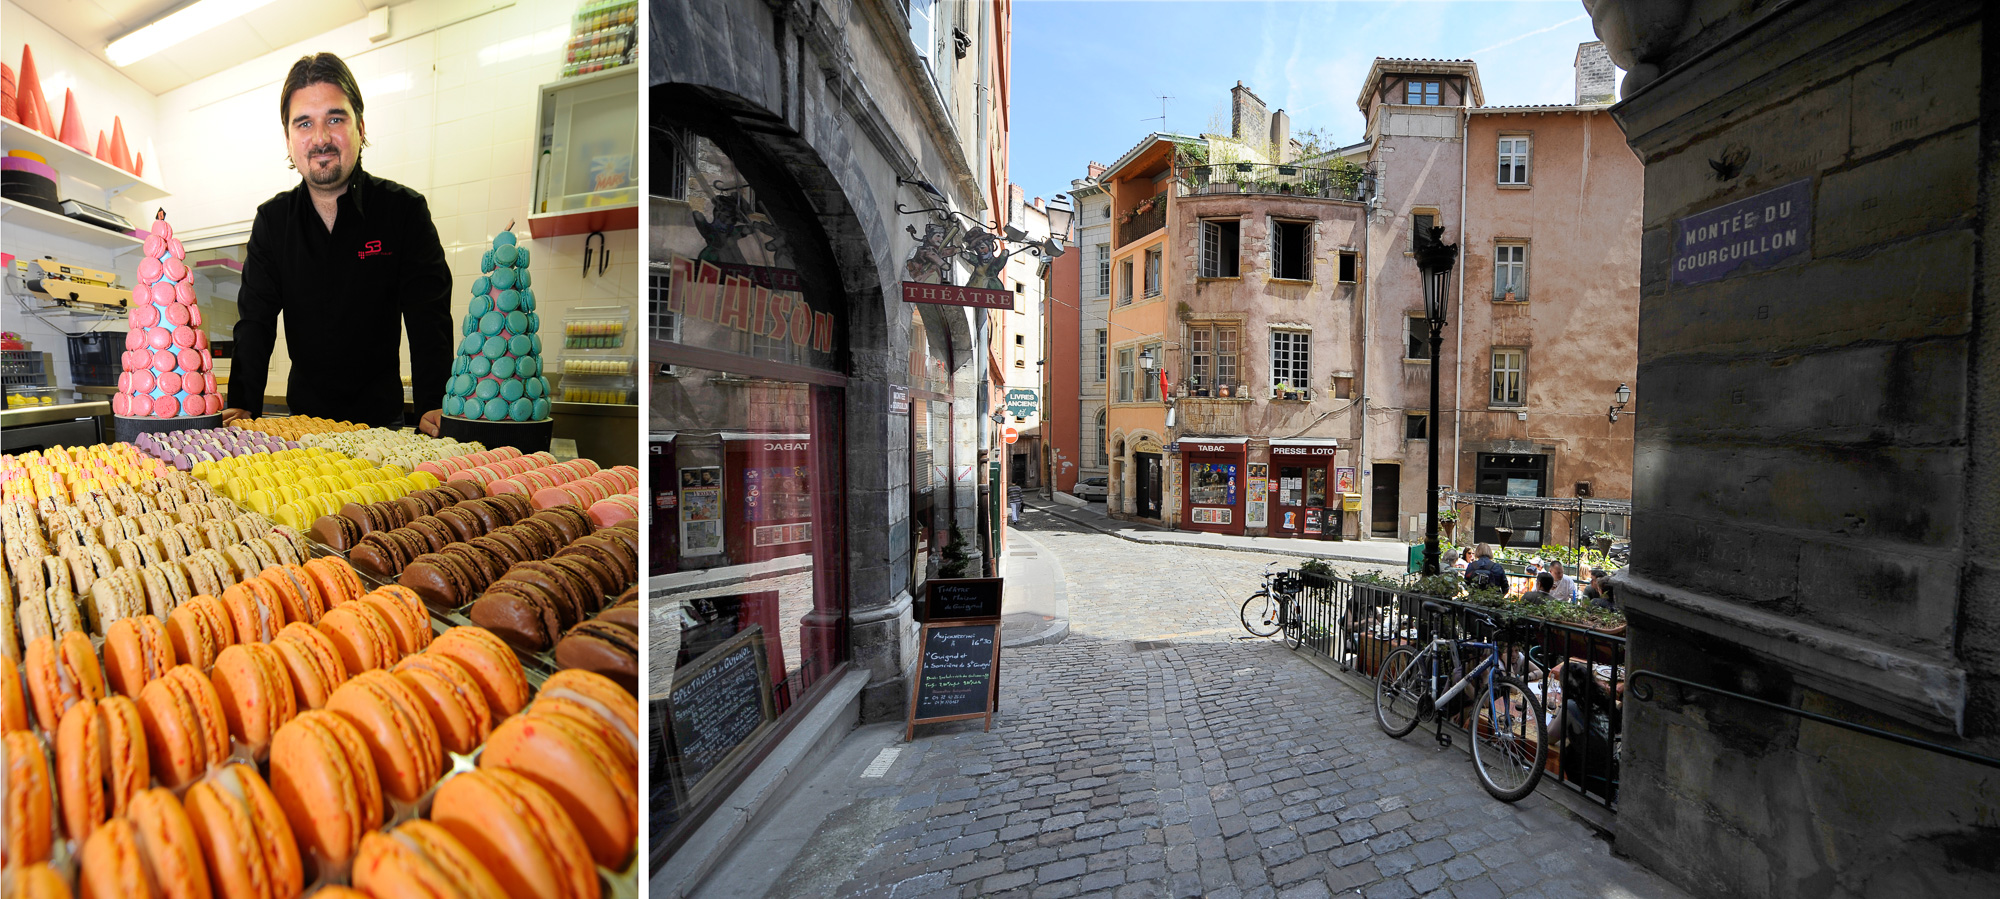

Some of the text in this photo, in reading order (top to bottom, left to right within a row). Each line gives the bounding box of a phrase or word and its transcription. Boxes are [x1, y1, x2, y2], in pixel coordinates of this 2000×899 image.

[1686, 201, 1790, 246] MONTÉE DU
[1678, 229, 1797, 272] GOURGUILLON
[667, 252, 834, 353] MAISON
[905, 286, 1011, 306] THÉÂTRE
[1197, 444, 1225, 452] TABAC
[1273, 447, 1307, 455] PRESSE
